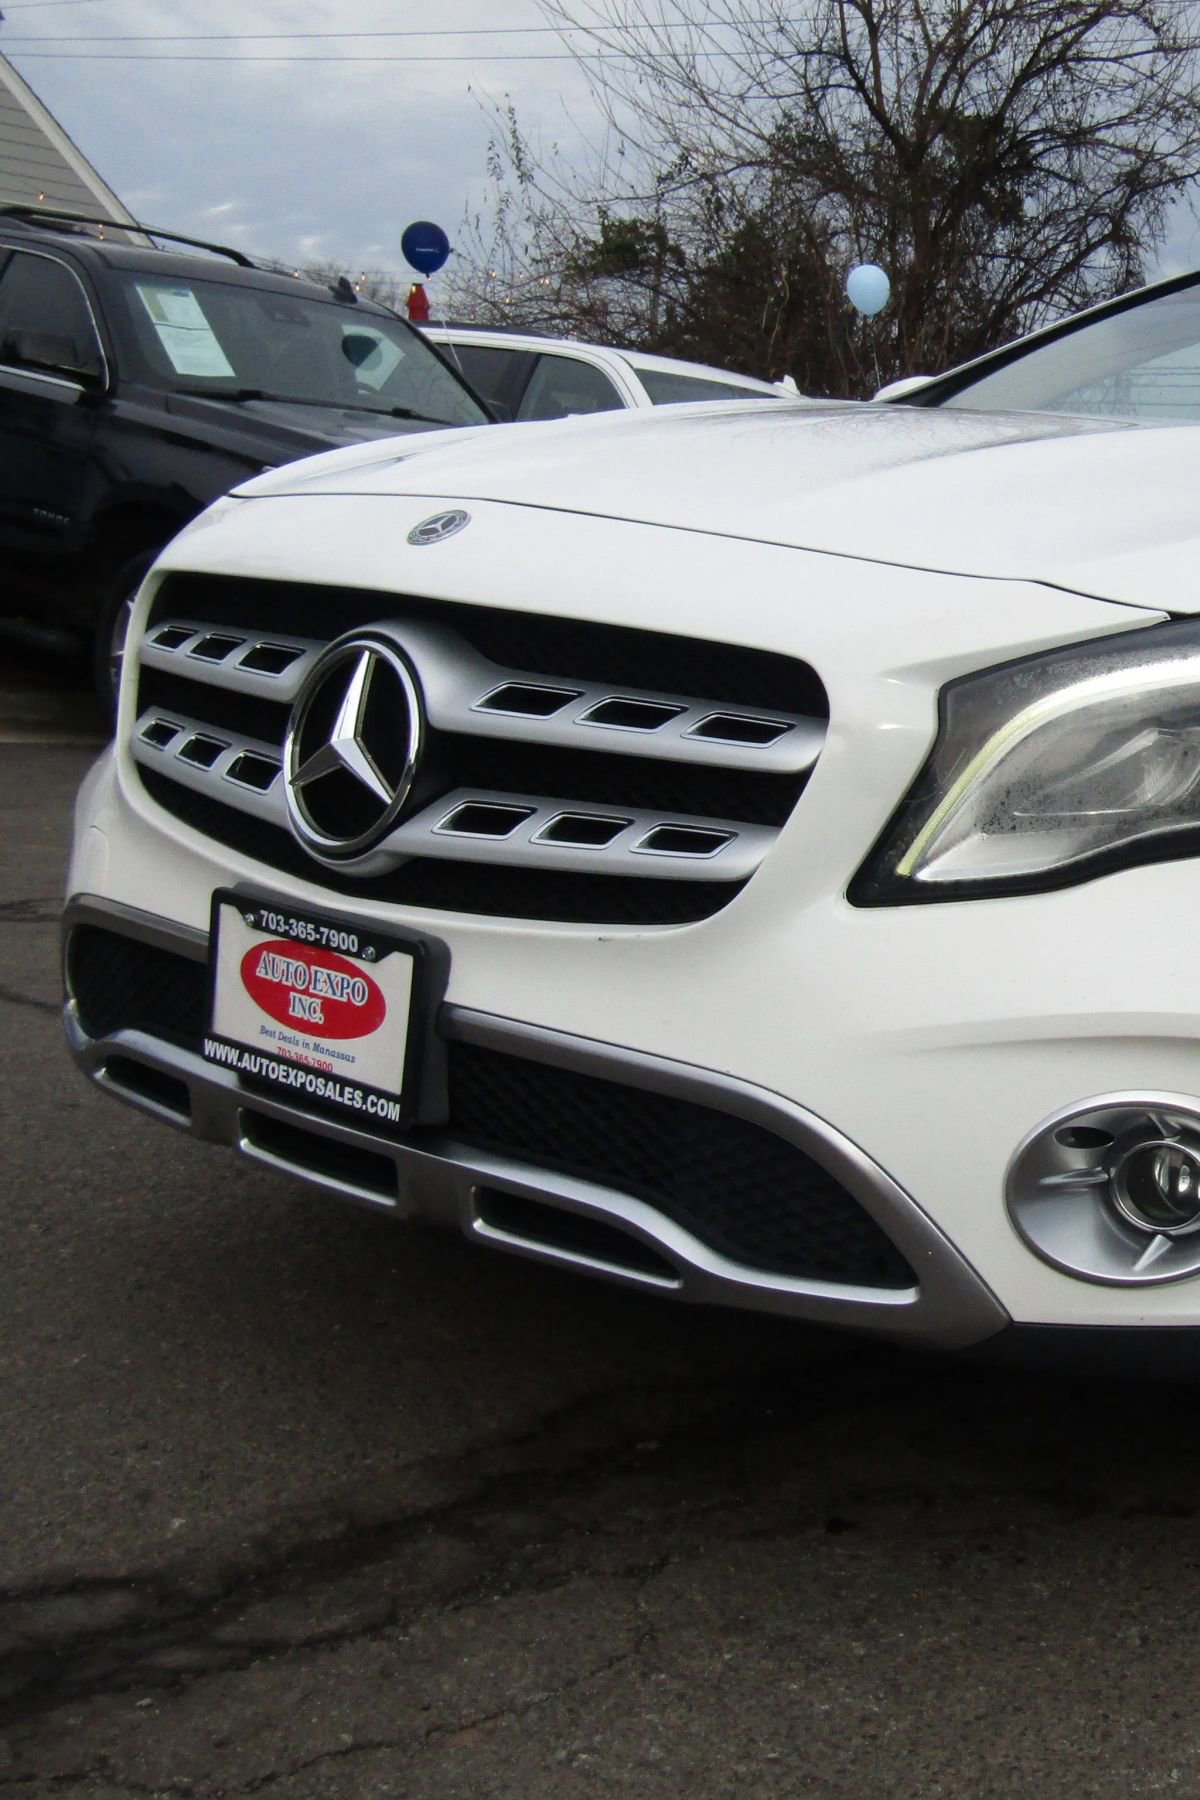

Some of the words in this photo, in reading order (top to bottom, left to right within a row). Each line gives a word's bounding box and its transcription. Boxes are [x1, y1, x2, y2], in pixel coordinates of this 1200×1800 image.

[260, 910, 358, 953] 703-365-7900
[257, 952, 308, 989] AUTO
[311, 966, 368, 1004] EXPO
[290, 993, 323, 1023] INC.
[259, 1025, 276, 1039] Best
[278, 1031, 299, 1047] Deals
[302, 1039, 310, 1050] in
[312, 1043, 356, 1064] Manassas
[277, 1047, 334, 1073] 703-365-7900
[204, 1038, 400, 1122] WWW.AUTOEXPOSALES.COM
